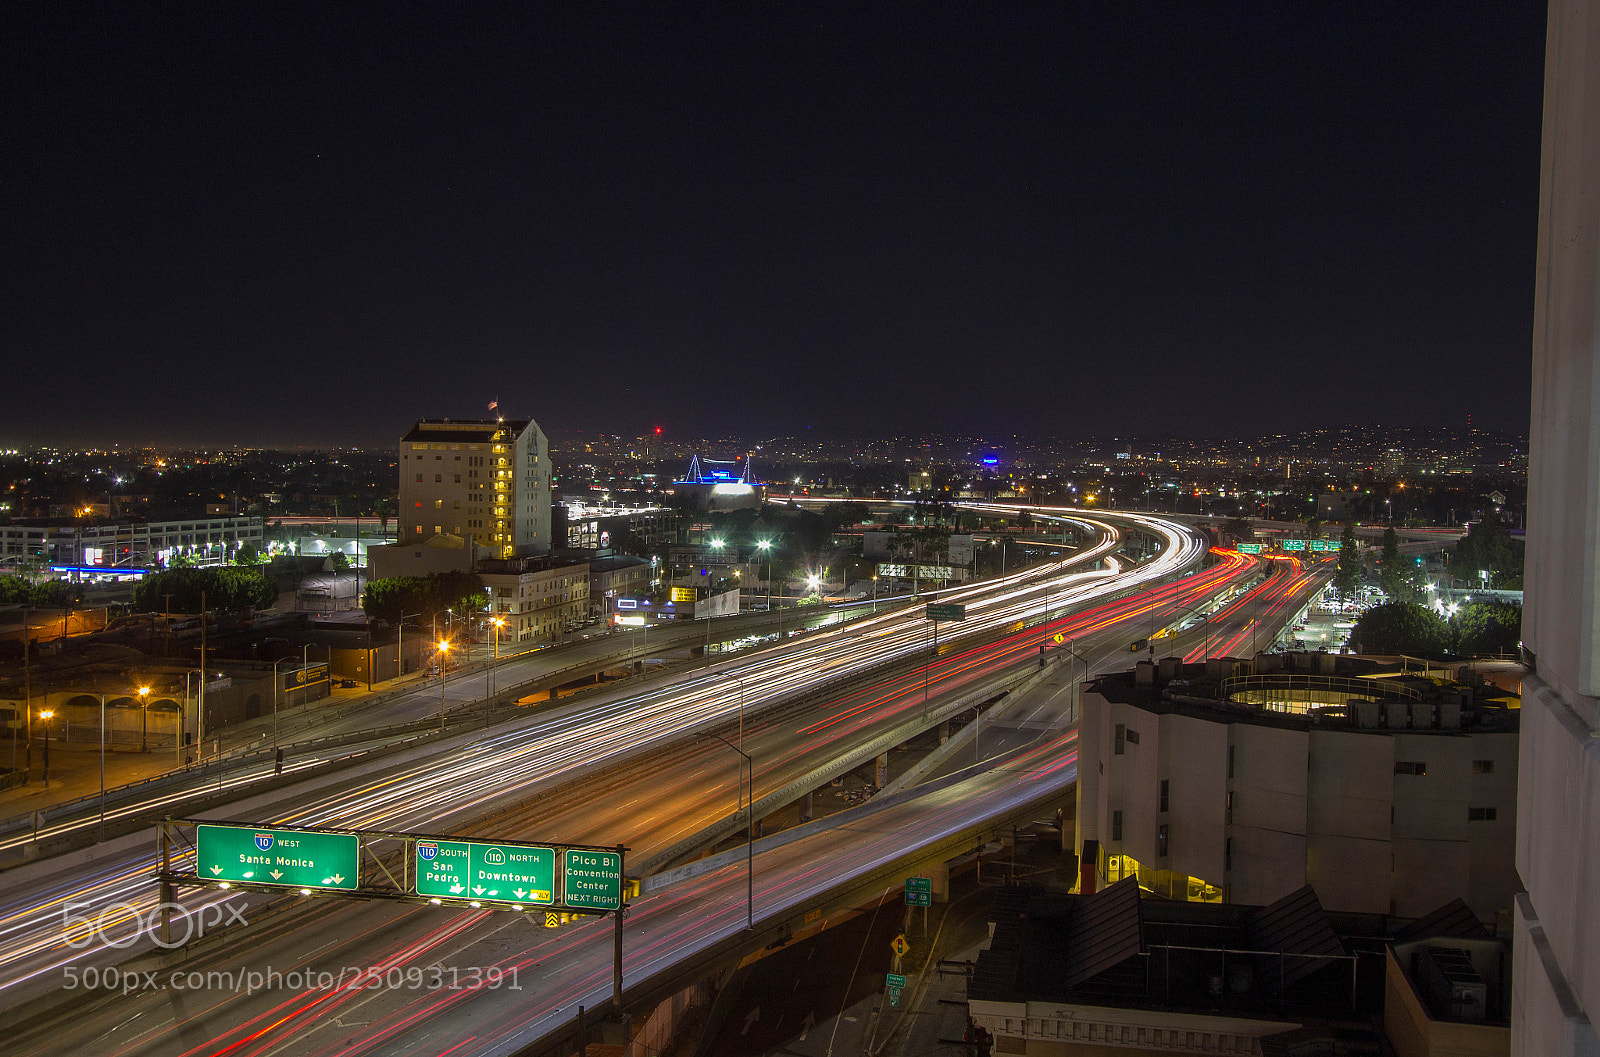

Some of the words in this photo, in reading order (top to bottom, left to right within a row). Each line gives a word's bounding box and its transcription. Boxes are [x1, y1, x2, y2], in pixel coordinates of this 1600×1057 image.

[259, 838, 269, 847] 10
[277, 839, 300, 848] WEST
[422, 848, 435, 857] 110
[440, 848, 468, 857] SOUTH
[488, 852, 501, 862] 110
[509, 854, 540, 863] NORTH
[239, 854, 271, 865] Santa
[276, 856, 314, 868] Monica
[433, 861, 453, 871] San
[572, 855, 597, 866] Pico
[426, 872, 459, 883] Pedro
[478, 870, 536, 883] Downtown
[566, 867, 619, 879] Convention
[577, 880, 609, 891] Center
[567, 893, 591, 902] NEXT
[592, 895, 618, 904] RIGHT
